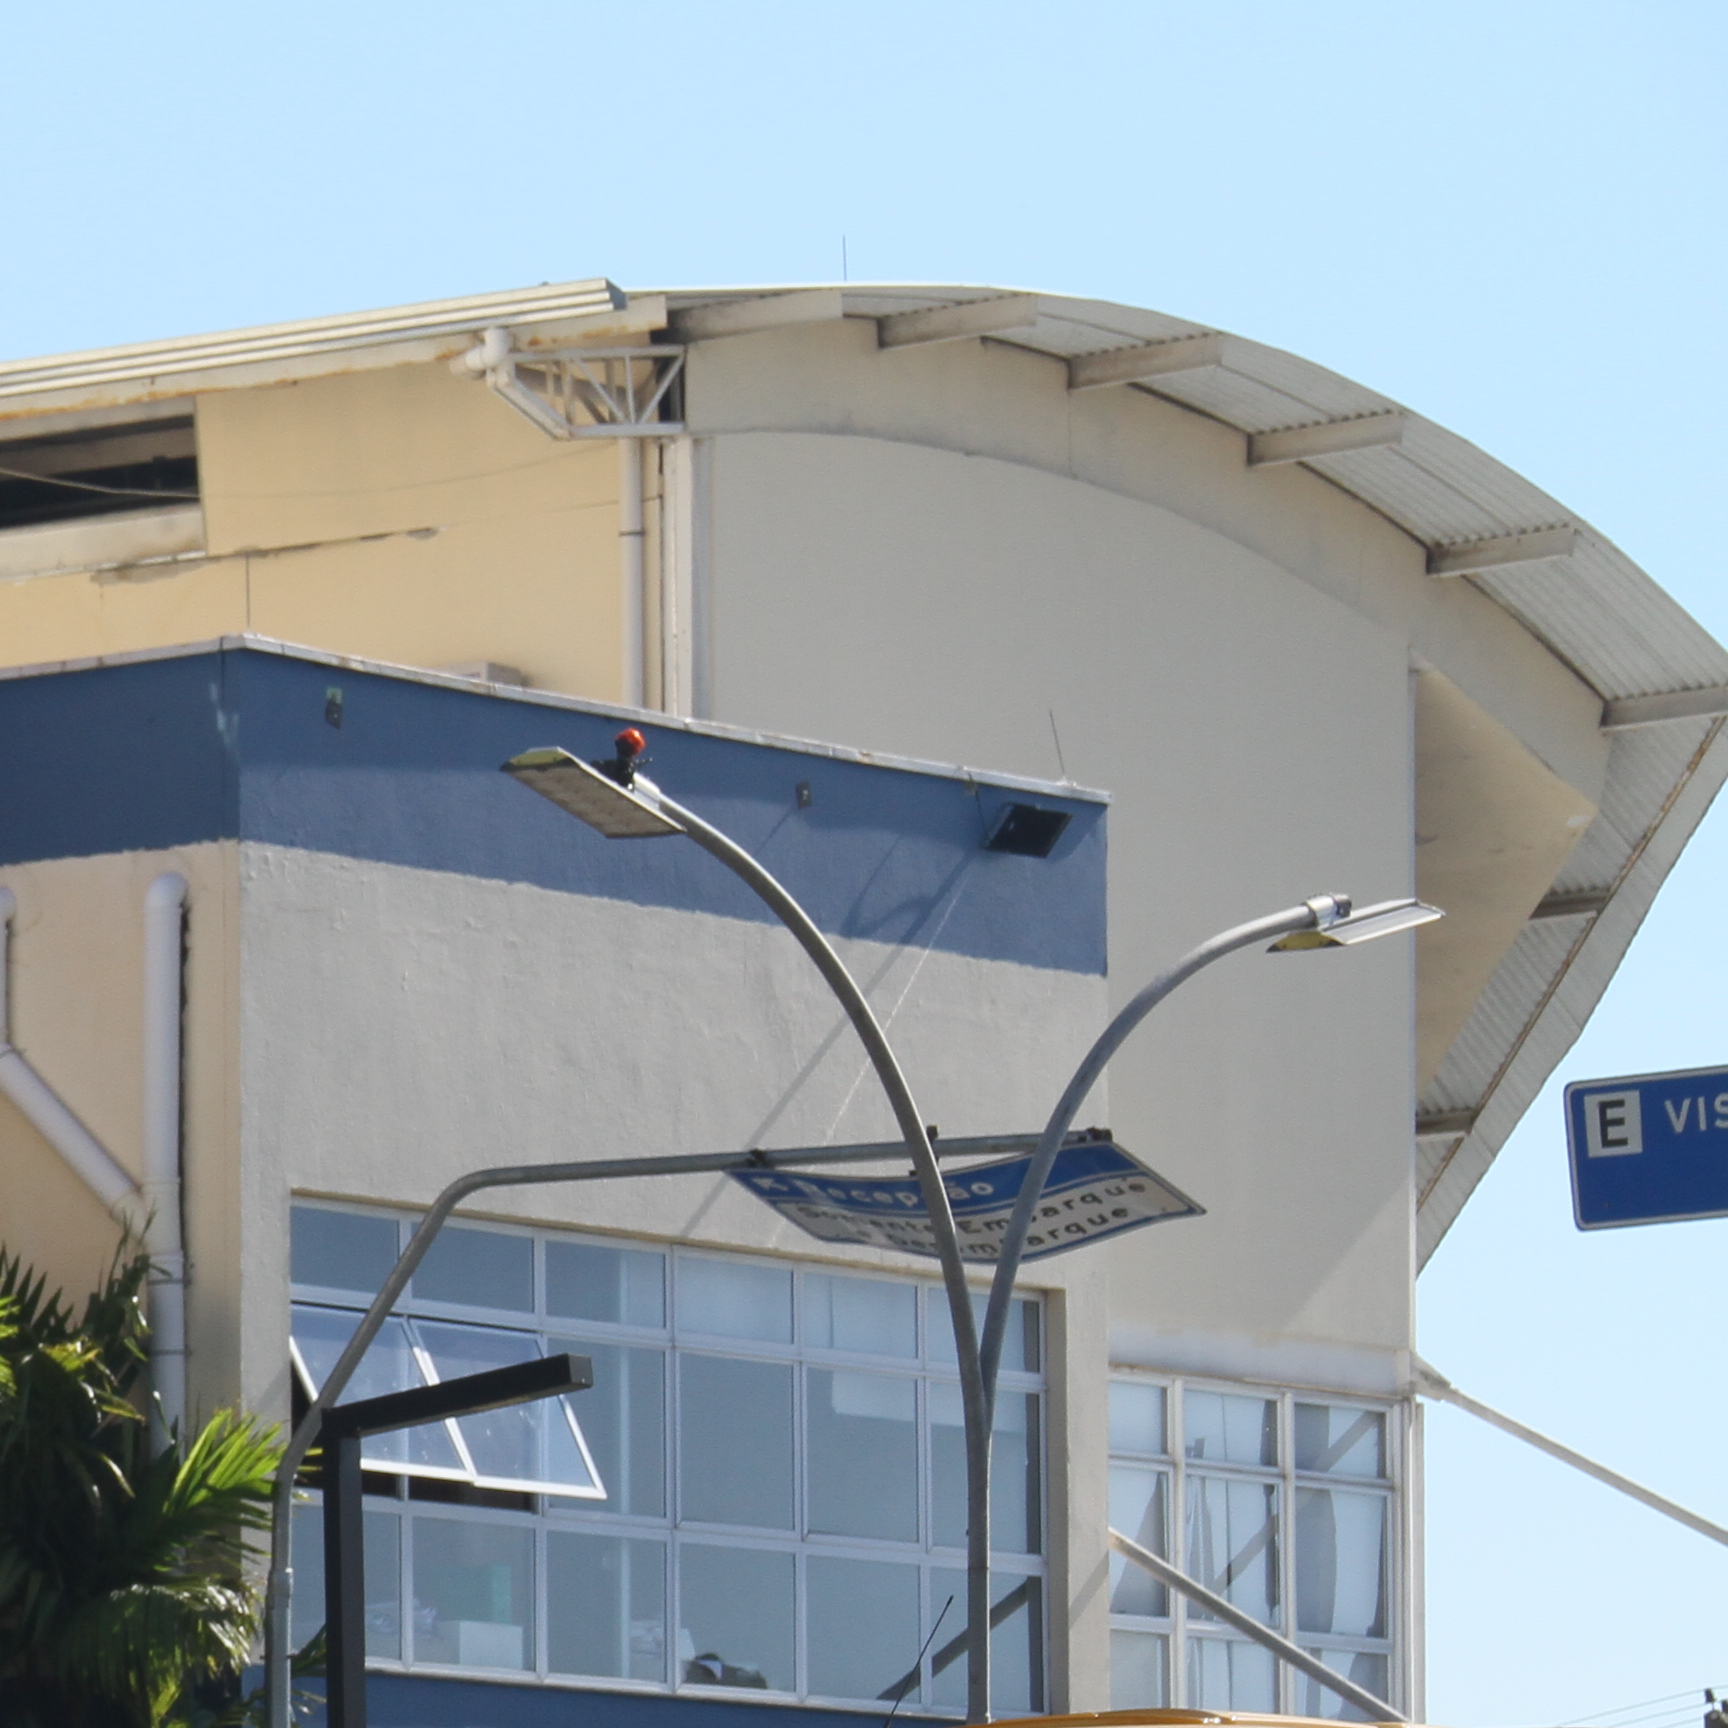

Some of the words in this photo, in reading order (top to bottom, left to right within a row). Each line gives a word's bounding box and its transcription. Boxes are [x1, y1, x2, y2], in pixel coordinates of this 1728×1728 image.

[1598, 1098, 1629, 1149] E
[793, 1179, 994, 1208] Recepão
[955, 1183, 1144, 1235] Emarque
